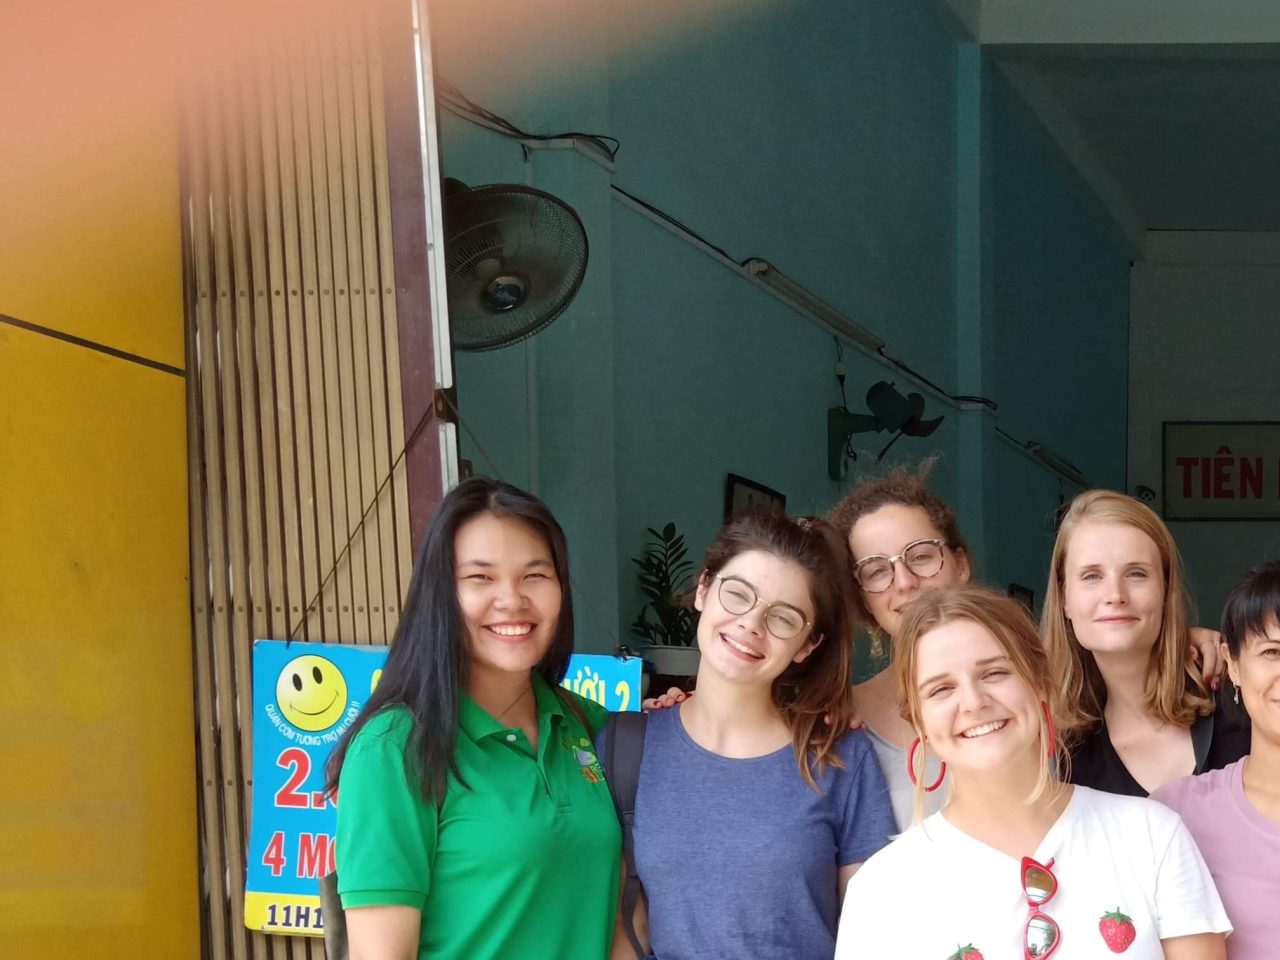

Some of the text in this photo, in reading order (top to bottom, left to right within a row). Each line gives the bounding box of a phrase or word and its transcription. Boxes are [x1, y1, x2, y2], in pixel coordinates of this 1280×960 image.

[1176, 445, 1264, 499] TIÊN
[262, 830, 337, 879] 4 M
